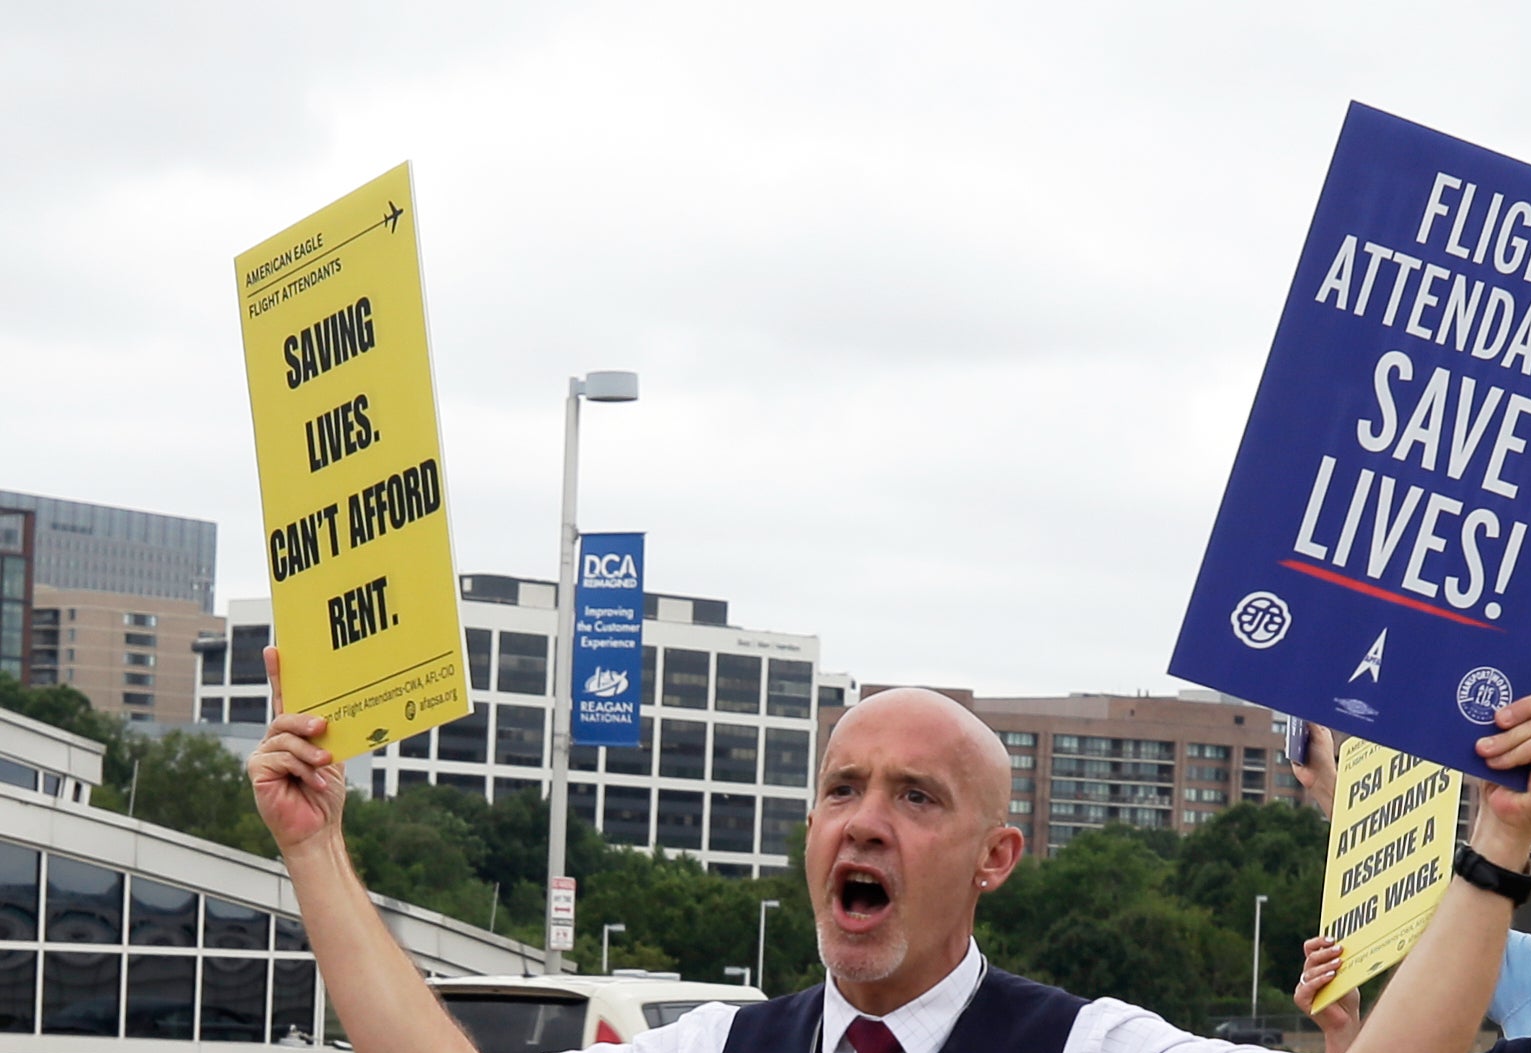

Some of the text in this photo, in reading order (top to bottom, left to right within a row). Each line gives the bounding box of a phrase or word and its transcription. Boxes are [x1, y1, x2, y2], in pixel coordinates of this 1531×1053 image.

[245, 232, 324, 288] AMERICAN EAGLE
[248, 258, 342, 319] FLIGHT ATTENDANTS
[283, 296, 375, 390] SAVING
[305, 394, 380, 473] LIVES.
[270, 458, 441, 582] CAN'T AFFORD
[1293, 455, 1528, 620] LIVES!
[583, 553, 637, 578] DCA
[583, 578, 637, 589] REIMAGINED
[328, 575, 399, 650] RENT.
[577, 621, 640, 633] the Customer
[584, 605, 634, 620] Improving
[580, 636, 636, 651] Experience
[334, 708, 342, 722] of
[343, 701, 363, 718] Flight
[580, 701, 633, 713] REAGAN
[580, 713, 633, 724] NATIONAL
[1336, 767, 1450, 859] ATTENDANTS
[1348, 765, 1382, 810] PSA
[1340, 816, 1435, 898] DESERVE A
[1324, 895, 1378, 943] LIVING
[1384, 856, 1443, 914] WAGE.
